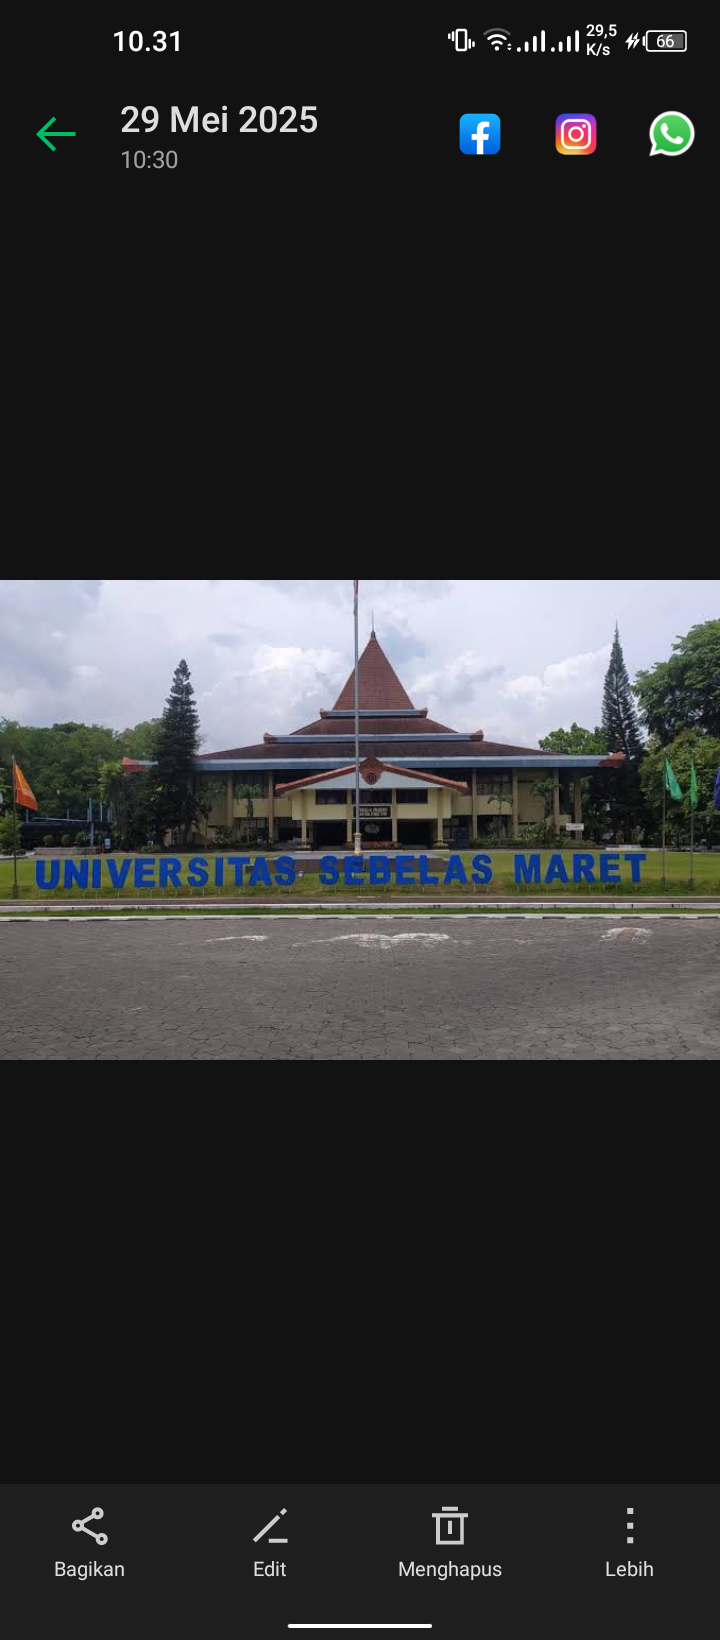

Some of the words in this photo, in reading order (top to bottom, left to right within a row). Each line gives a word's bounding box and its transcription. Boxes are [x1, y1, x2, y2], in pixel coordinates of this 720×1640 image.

[113, 29, 180, 53] 10.31
[586, 24, 618, 39] 29,5
[656, 34, 674, 48] 66
[586, 43, 611, 57] K/s
[120, 104, 160, 134] 29
[171, 104, 228, 134] Mei
[238, 104, 318, 134] 2025
[121, 150, 178, 169] 10:30
[35, 856, 296, 889] UNIVERSITAS
[319, 854, 492, 885] SEBELAS
[514, 853, 647, 882] MARET
[54, 1560, 125, 1581] Bagikan
[253, 1560, 287, 1578] Edit
[398, 1560, 503, 1581] Menghapus
[605, 1560, 654, 1578] Lebih
